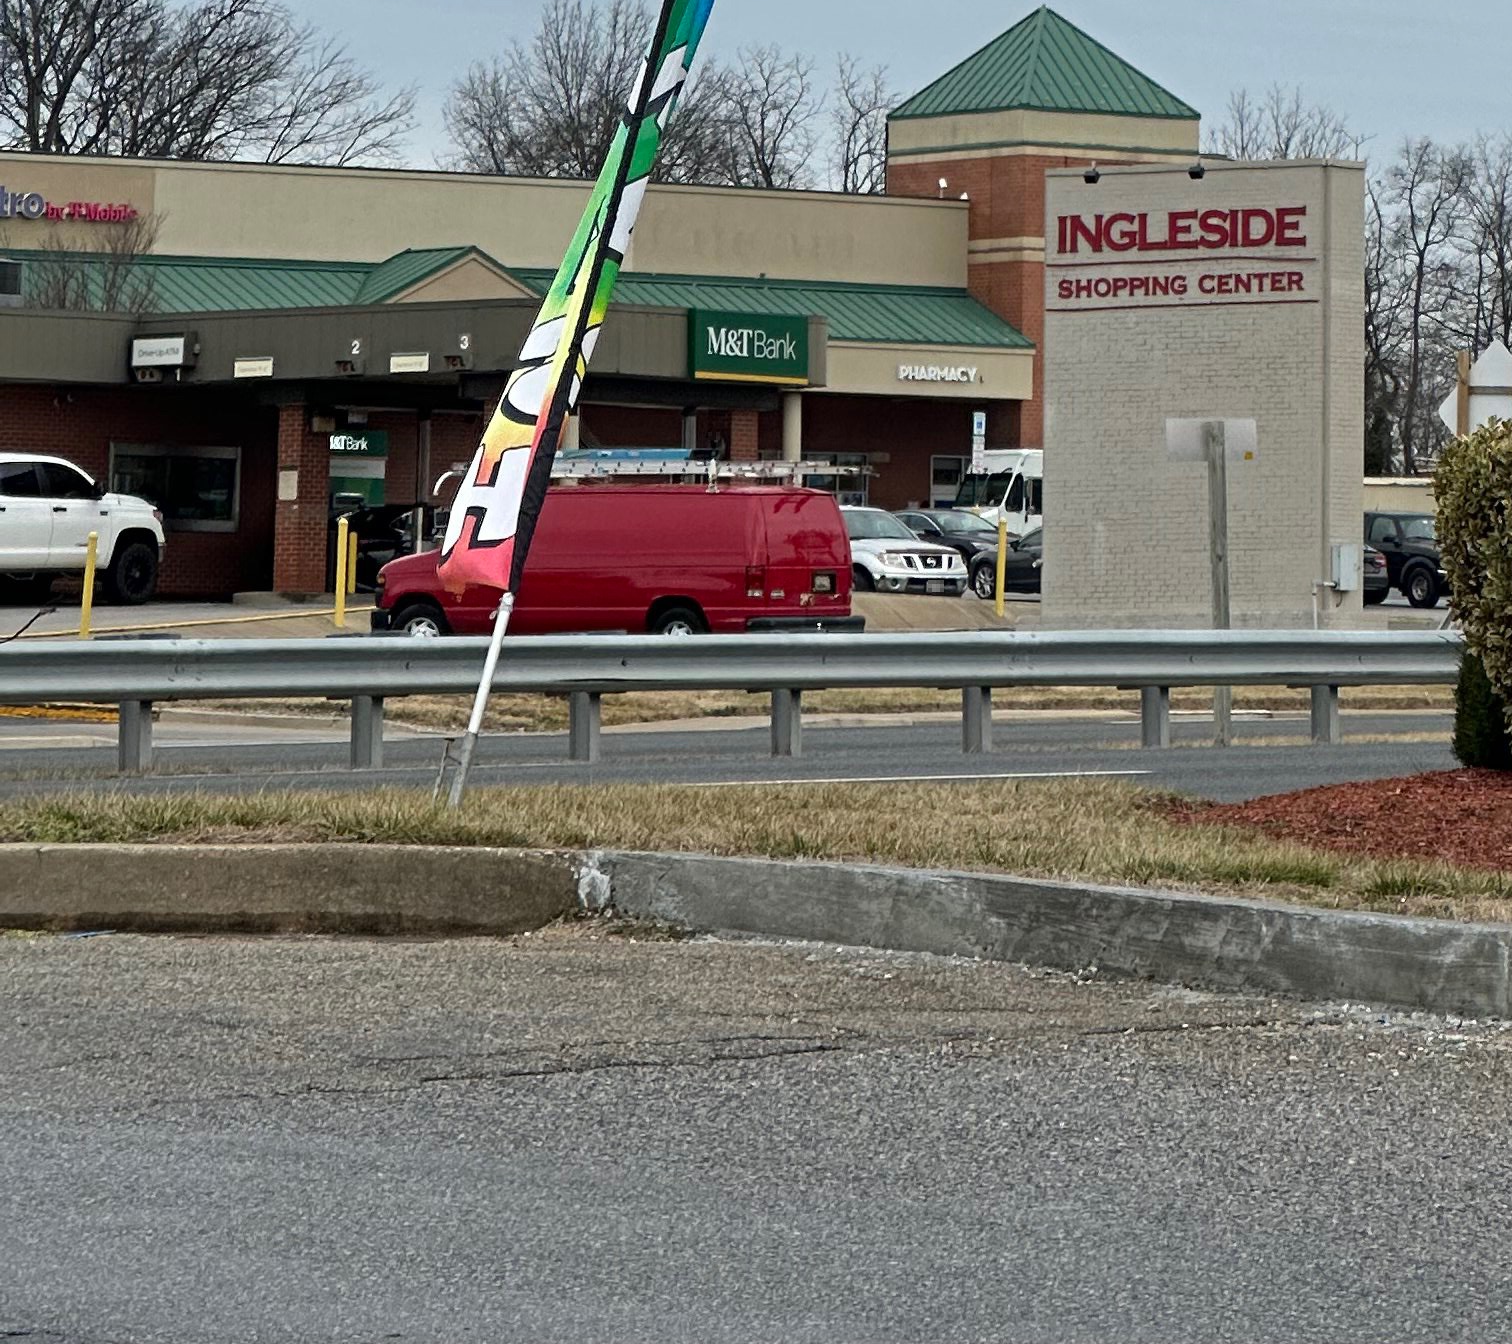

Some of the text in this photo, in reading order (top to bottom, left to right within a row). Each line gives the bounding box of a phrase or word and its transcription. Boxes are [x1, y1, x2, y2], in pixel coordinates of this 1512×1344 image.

[1057, 205, 1307, 254] INGLESIDE
[1058, 271, 1305, 299] SHOPPING CENTER
[351, 340, 361, 354] 2
[460, 335, 469, 350] 3
[707, 326, 796, 360] M&T Bank
[898, 364, 977, 382] PHARMACY
